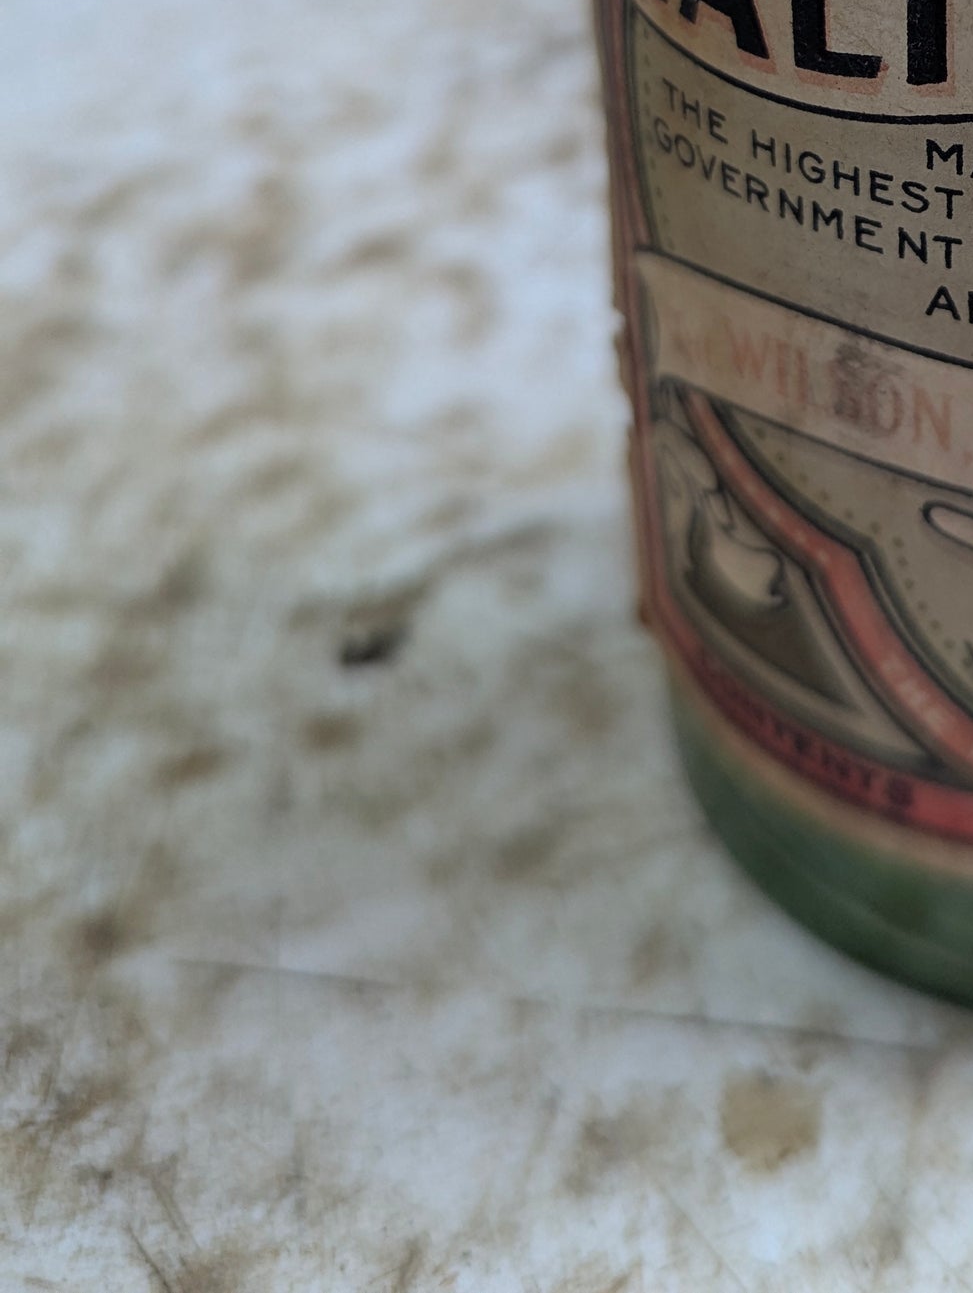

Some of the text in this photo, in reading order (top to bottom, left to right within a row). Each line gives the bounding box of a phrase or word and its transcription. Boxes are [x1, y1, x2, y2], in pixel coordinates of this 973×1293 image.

[652, 116, 963, 269] GOVERNMENT
[661, 77, 729, 144] THE
[752, 128, 964, 219] HIGHEST
